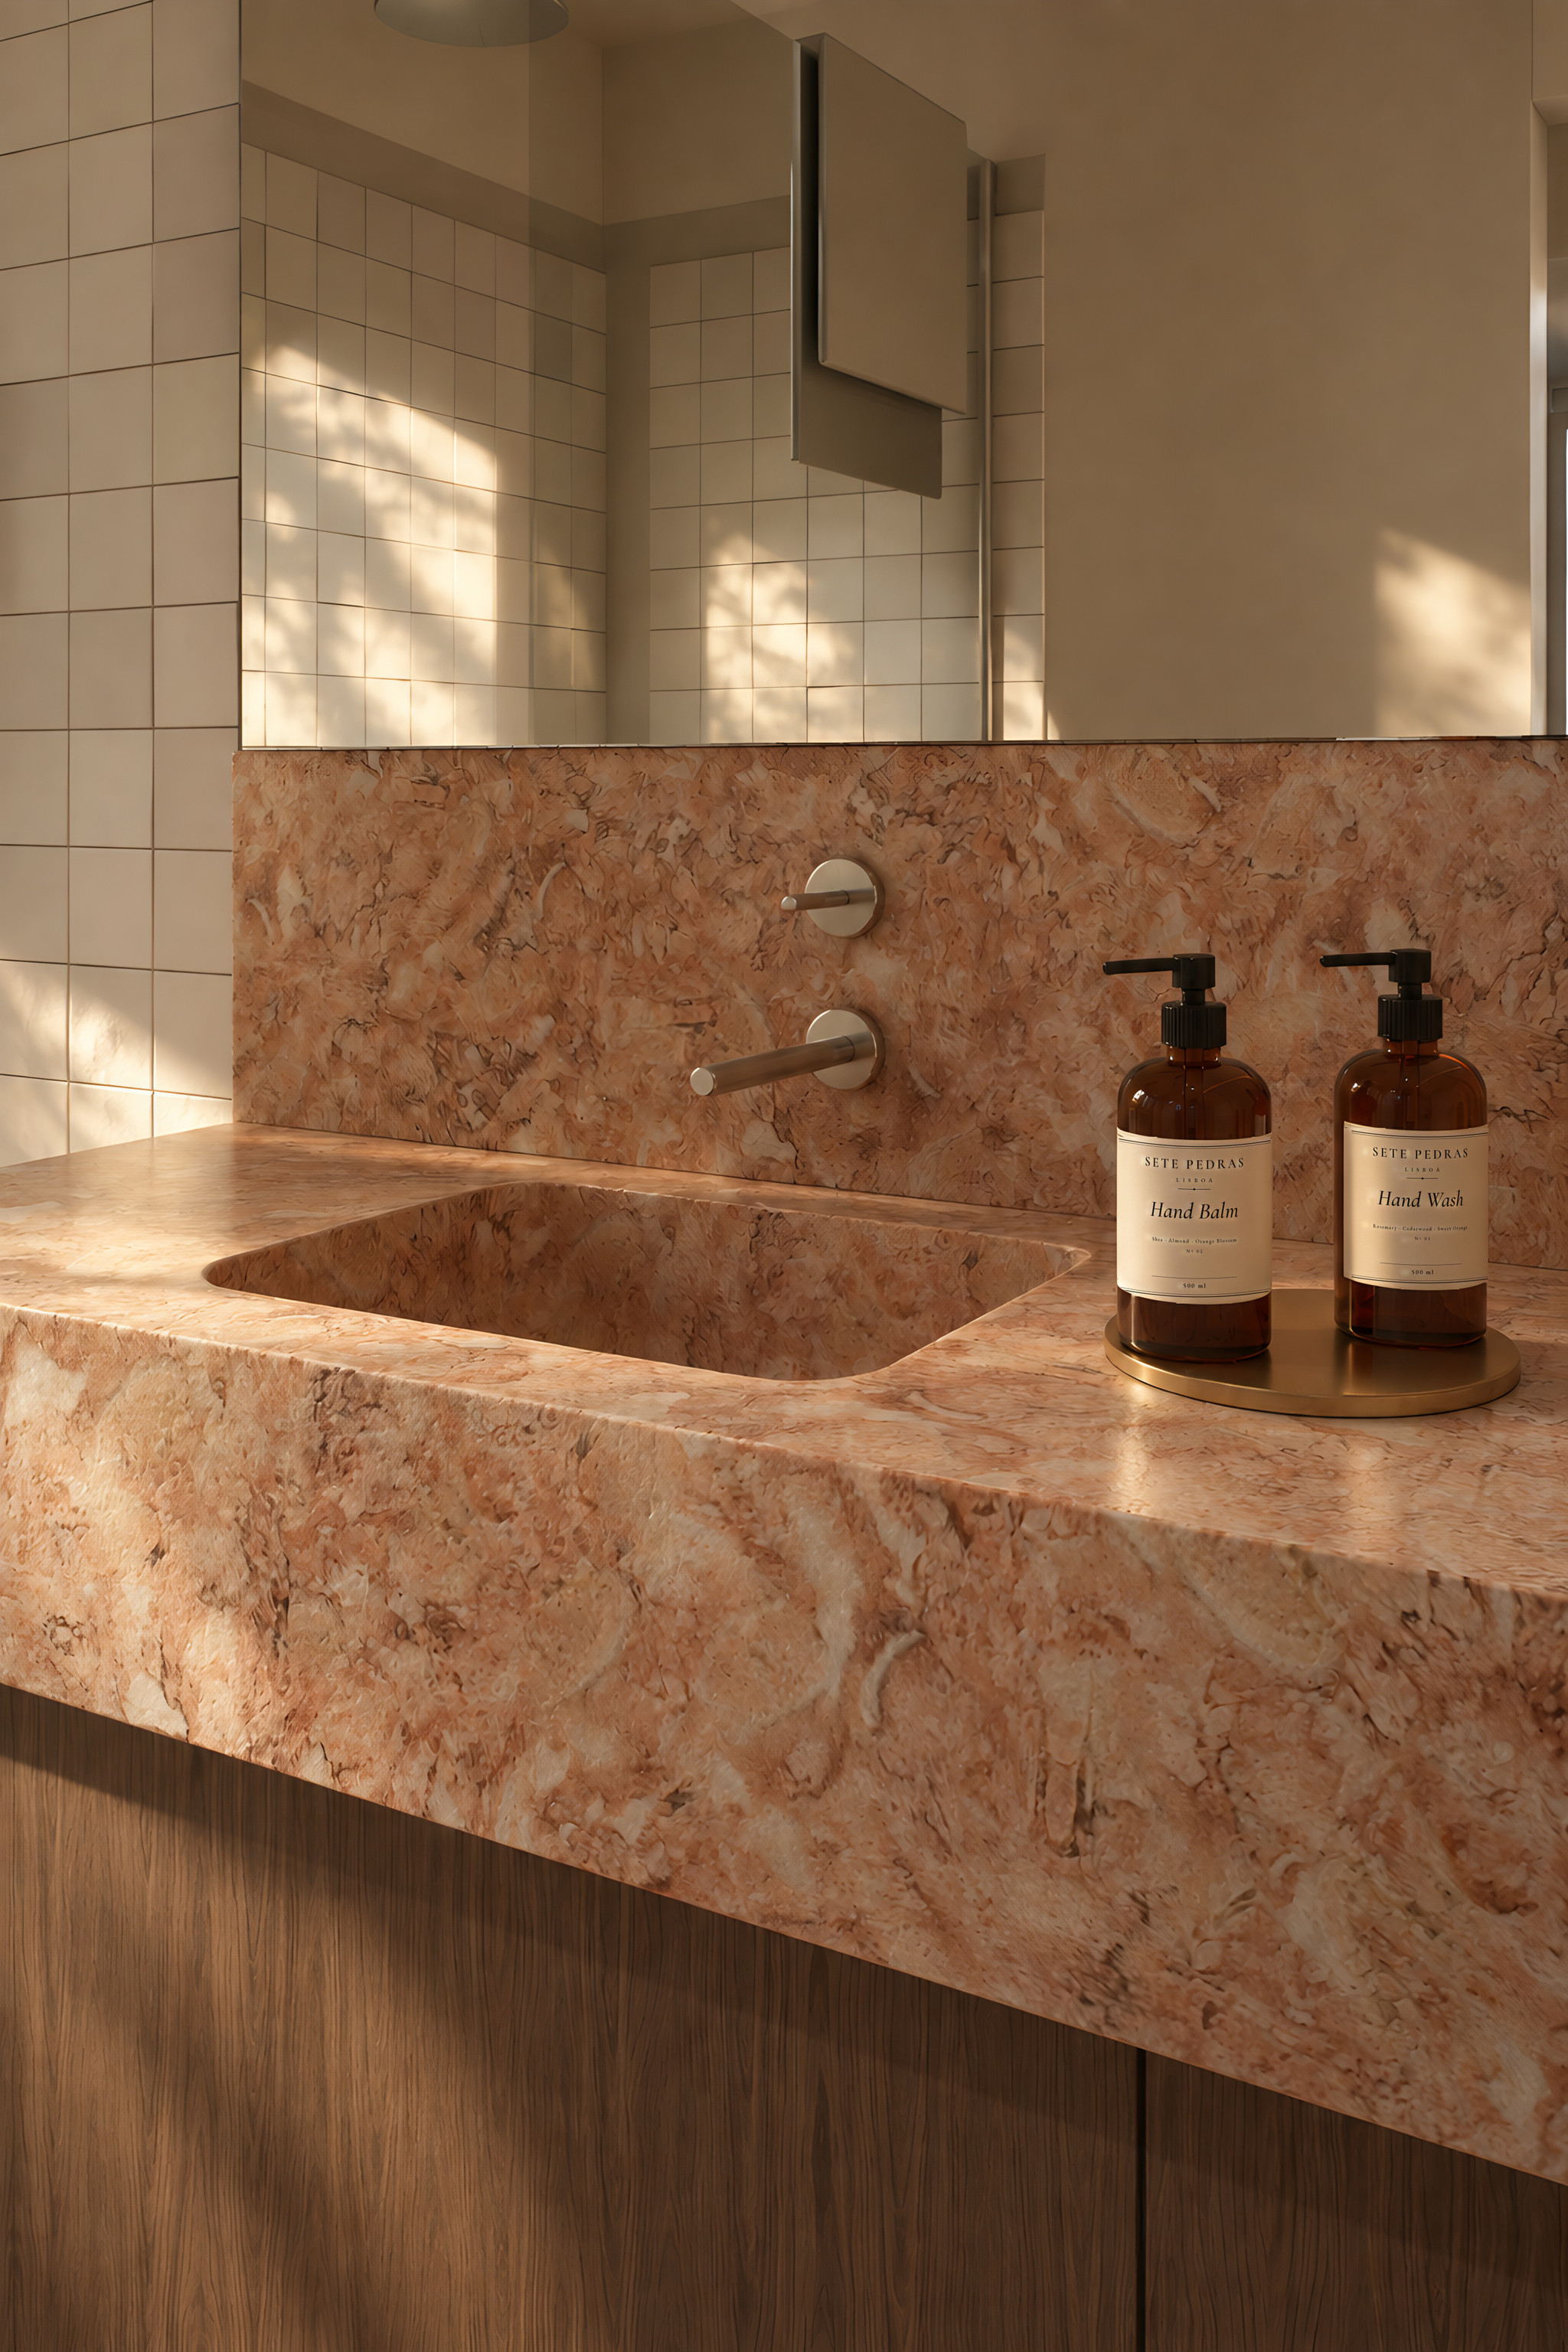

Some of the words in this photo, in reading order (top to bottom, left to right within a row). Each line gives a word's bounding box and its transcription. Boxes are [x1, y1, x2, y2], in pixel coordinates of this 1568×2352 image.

[1372, 1146, 1407, 1158] SETE
[1415, 1148, 1468, 1160] PEDRAS
[1145, 1156, 1179, 1170] SETE
[1187, 1157, 1244, 1170] PEDRAS
[1377, 1190, 1422, 1207] Hand
[1428, 1190, 1463, 1207] Wash
[1151, 1201, 1194, 1220] Hand
[1200, 1201, 1239, 1220] Balm
[1373, 1223, 1397, 1232] Rosemary
